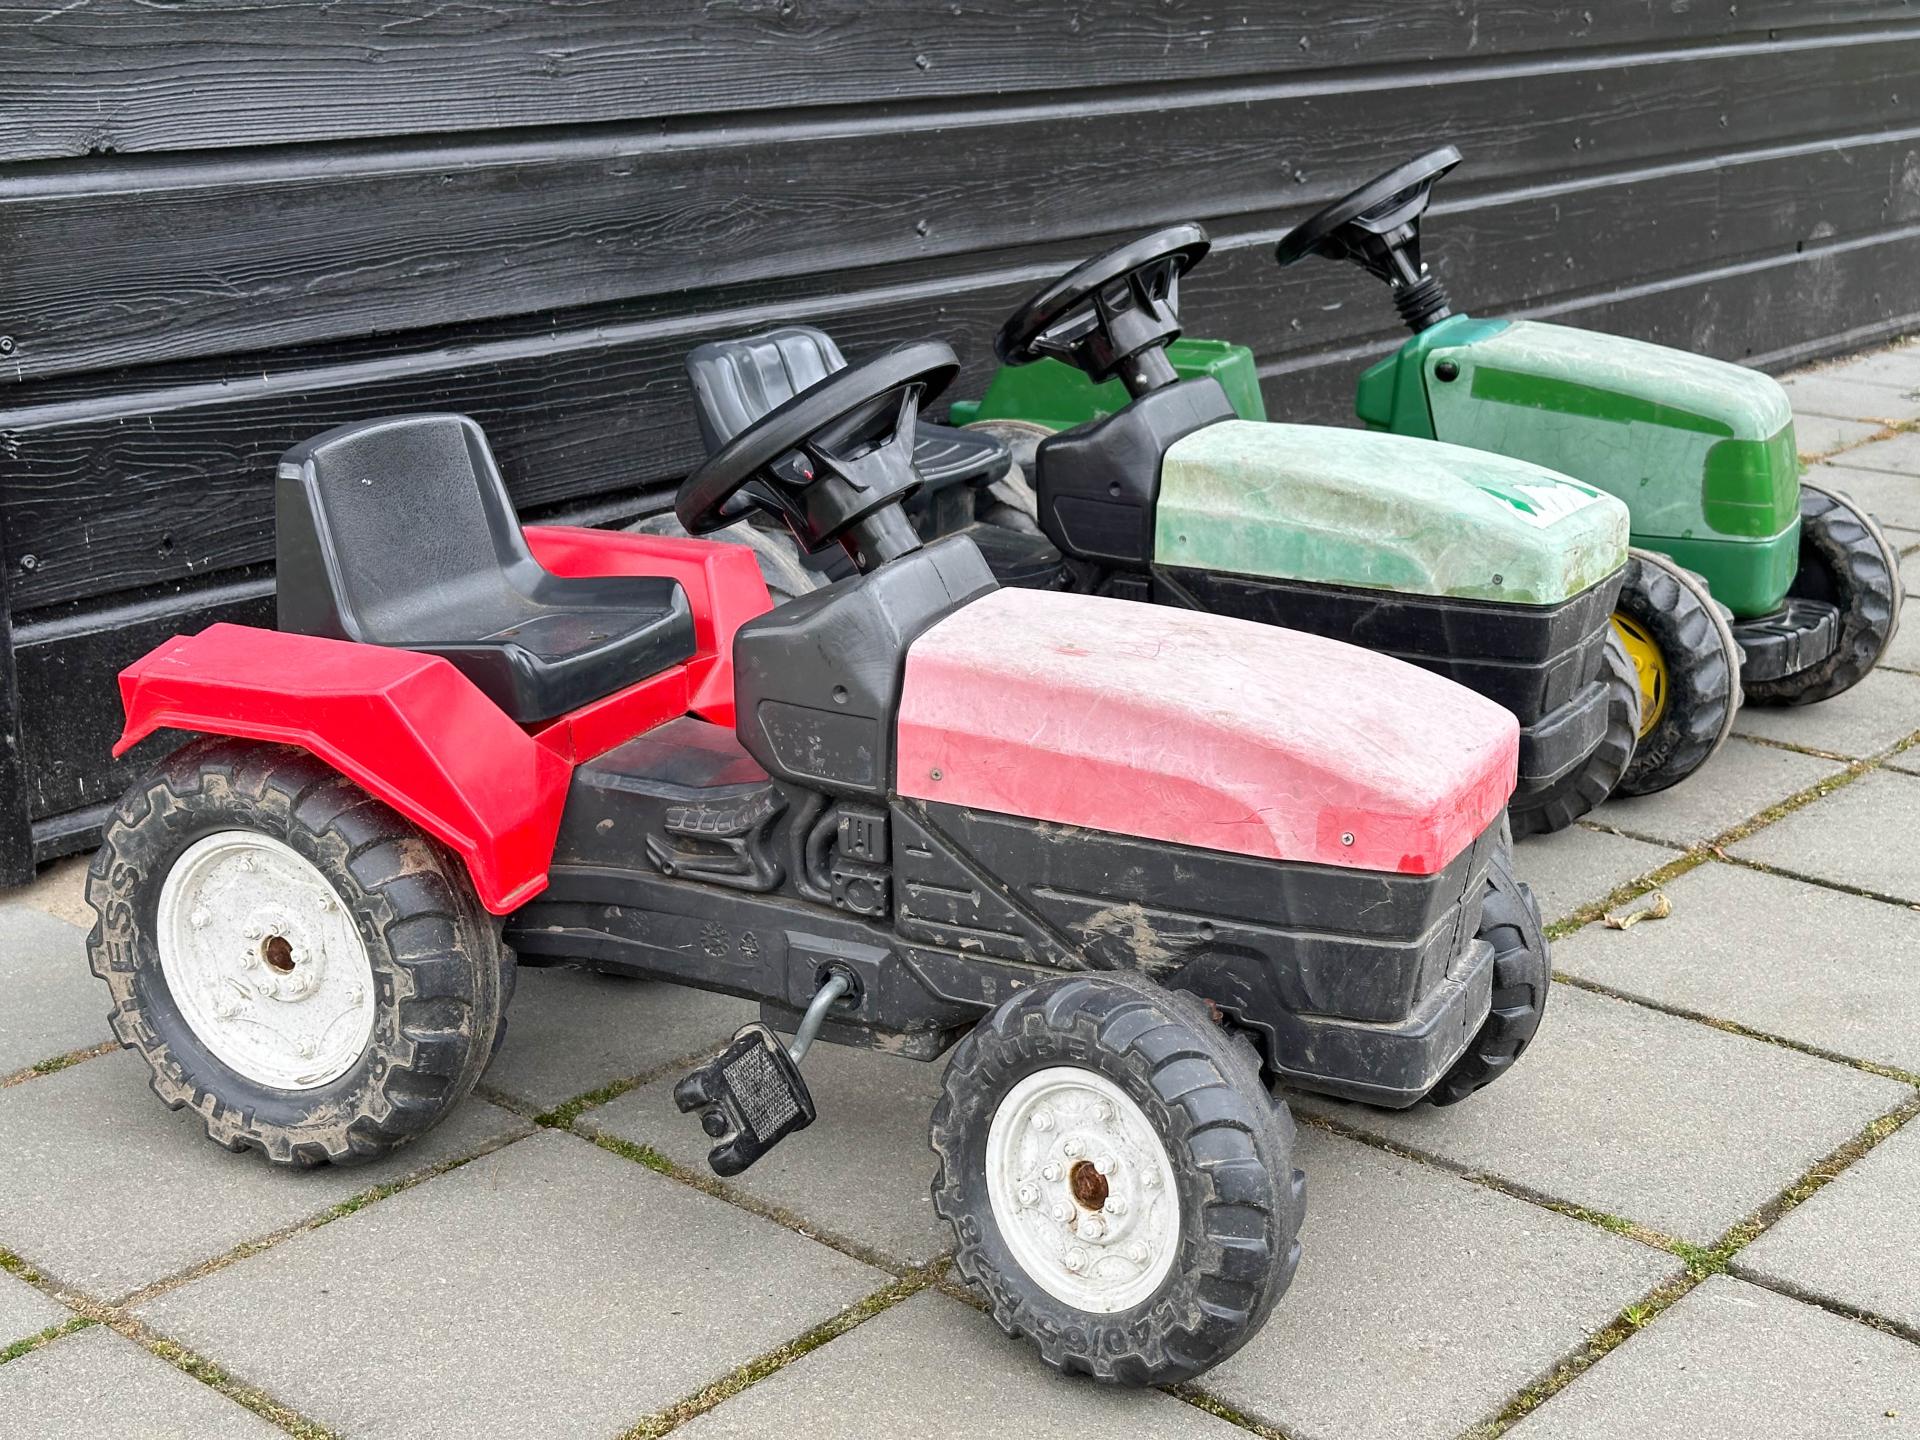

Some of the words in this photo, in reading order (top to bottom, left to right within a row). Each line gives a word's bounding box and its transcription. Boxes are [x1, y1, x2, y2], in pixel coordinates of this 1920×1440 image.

[105, 862, 262, 1137] TUBELESS
[365, 969, 396, 1084] R38
[957, 1214, 1024, 1317] R28
[1034, 1296, 1180, 1357] 540/65
